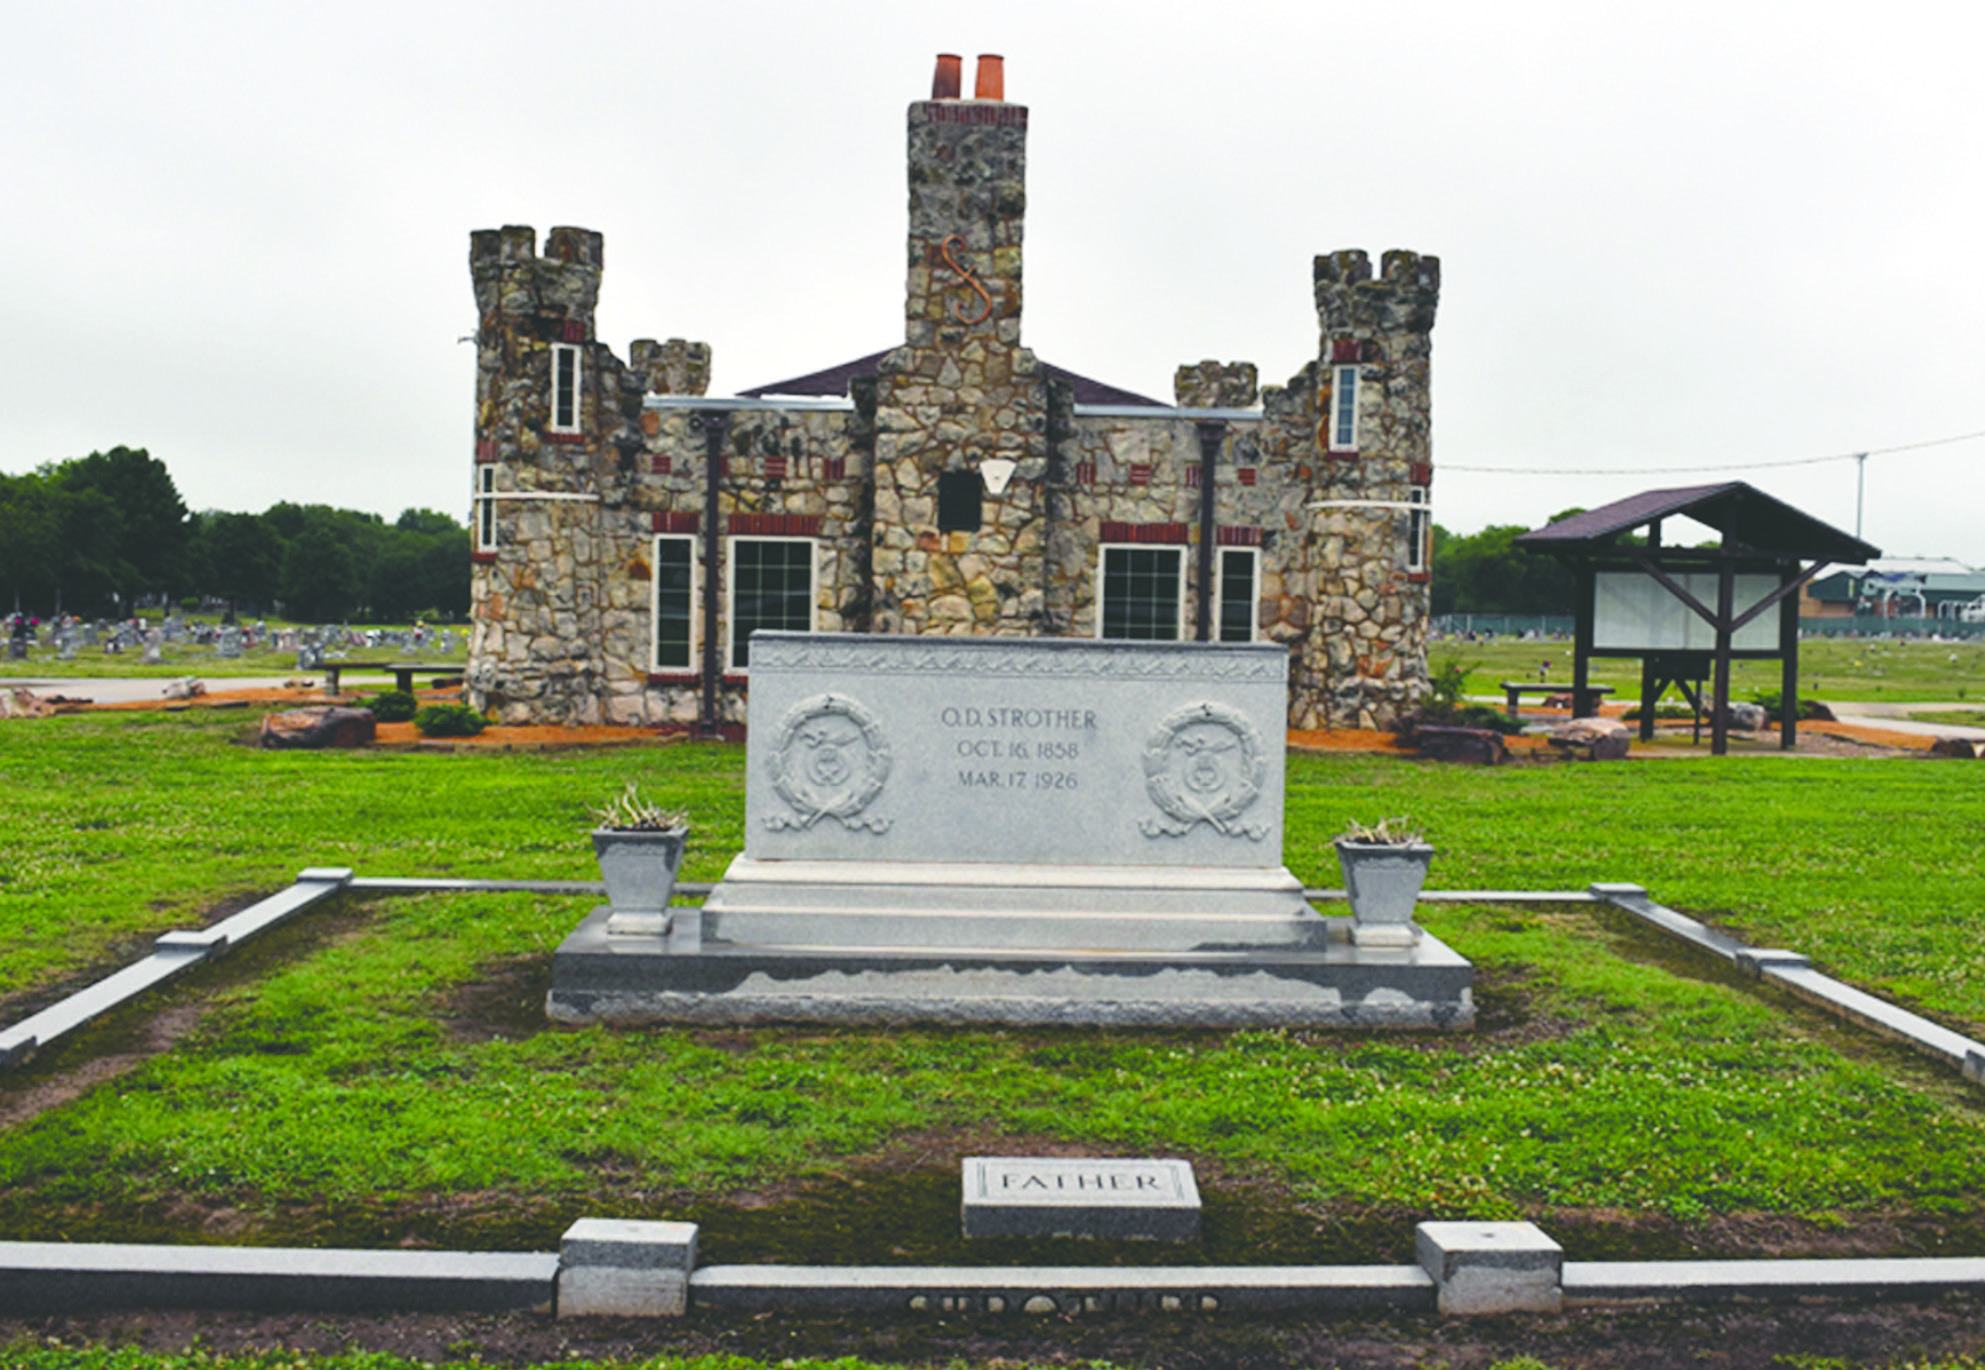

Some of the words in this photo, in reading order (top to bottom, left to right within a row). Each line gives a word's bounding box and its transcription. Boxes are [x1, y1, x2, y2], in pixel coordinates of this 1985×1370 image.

[987, 707, 1098, 729] STROTHER
[1037, 742, 1079, 760] 1858
[1035, 771, 1079, 790] 1926
[1002, 1174, 1160, 1190] FATHER
